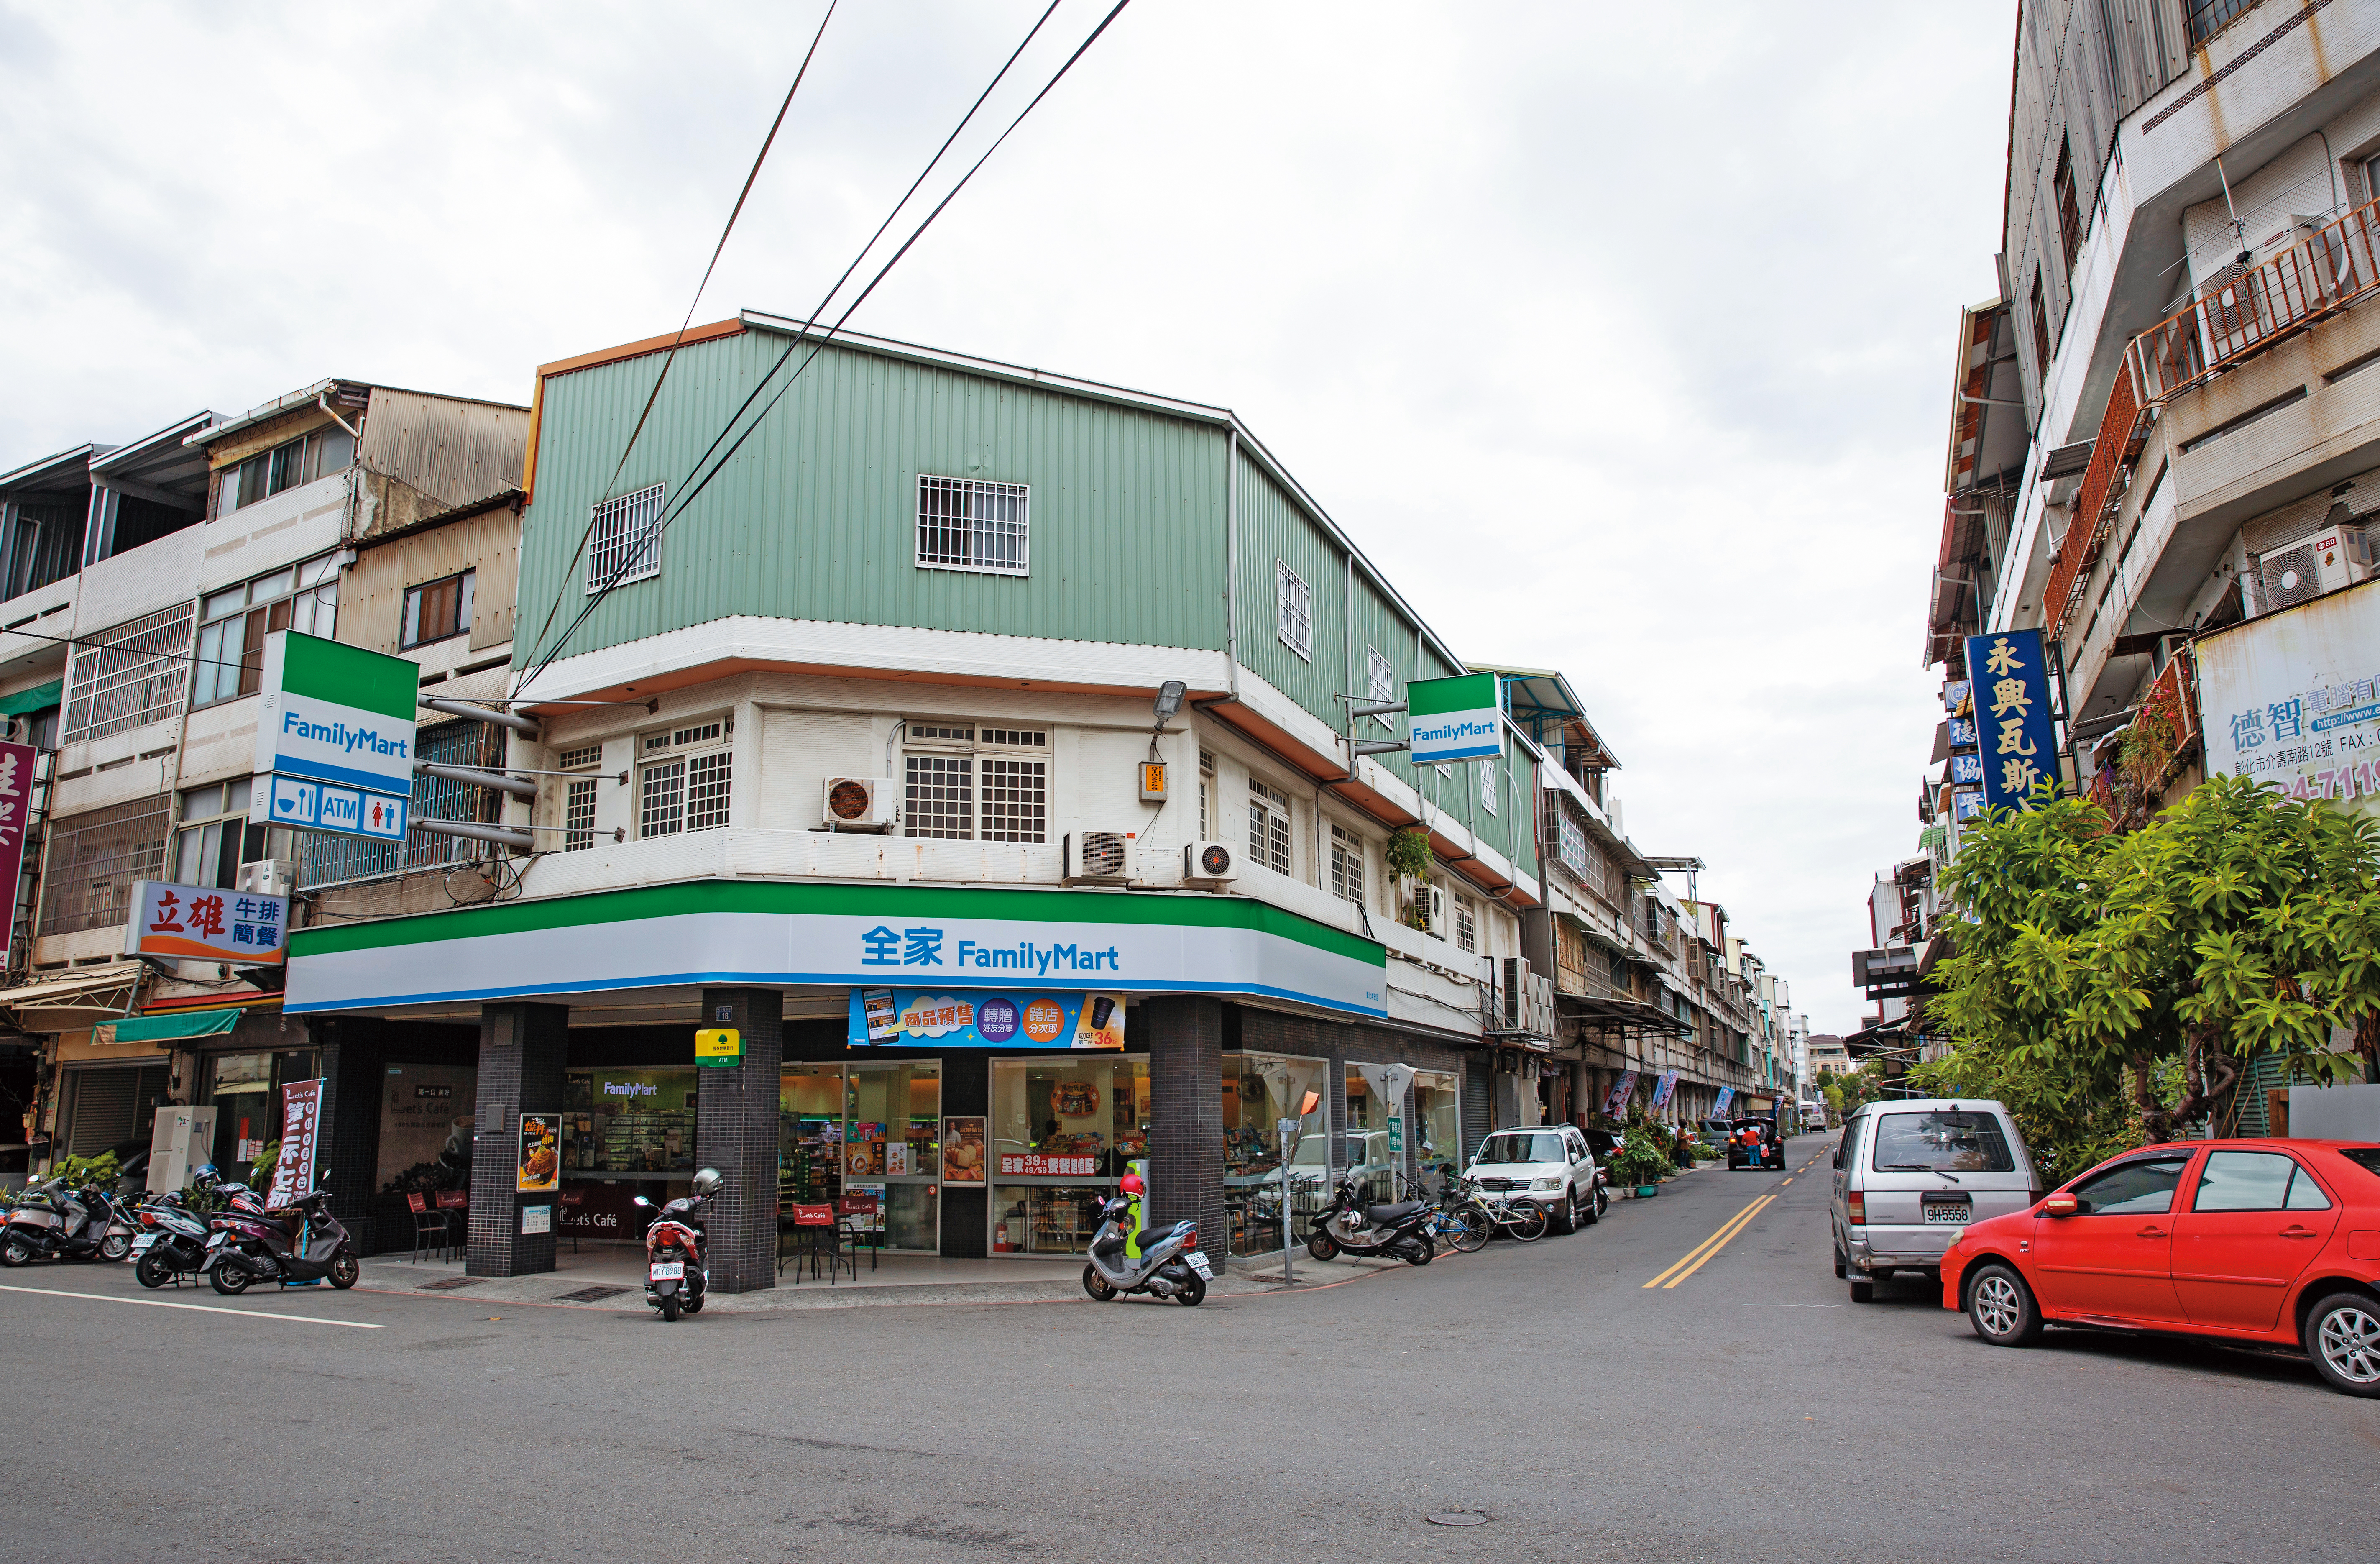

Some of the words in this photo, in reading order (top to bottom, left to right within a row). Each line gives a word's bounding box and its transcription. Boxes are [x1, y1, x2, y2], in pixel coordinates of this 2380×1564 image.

[1413, 721, 1495, 741] FamilyMart
[2229, 698, 2300, 751] 德智
[283, 712, 408, 758] FamilyMart
[2235, 740, 2333, 776] 彰化市介壽南路12號
[323, 796, 356, 821] ATM
[150, 890, 225, 939] 立雄
[235, 898, 280, 921] 牛排
[233, 923, 278, 947] 簡餐
[862, 926, 943, 966] 全家
[958, 940, 1119, 976] FamilyMart
[904, 1004, 974, 1027] 商品預售
[984, 1007, 1013, 1023] 轉贈
[1029, 1007, 1058, 1023] 跨店
[983, 1024, 1013, 1033] 好友分享
[1029, 1024, 1058, 1034] 分次取
[1095, 1032, 1112, 1045] 36
[286, 1089, 303, 1099] Let's
[604, 1082, 657, 1098] FamilyMart
[267, 1101, 306, 1208] 第二杯七折
[1002, 1157, 1024, 1173] 全家
[846, 1201, 860, 1209] Let's
[593, 1213, 617, 1226] Café
[798, 1209, 813, 1218] Let's
[1928, 1209, 1968, 1221] 9H-5558
